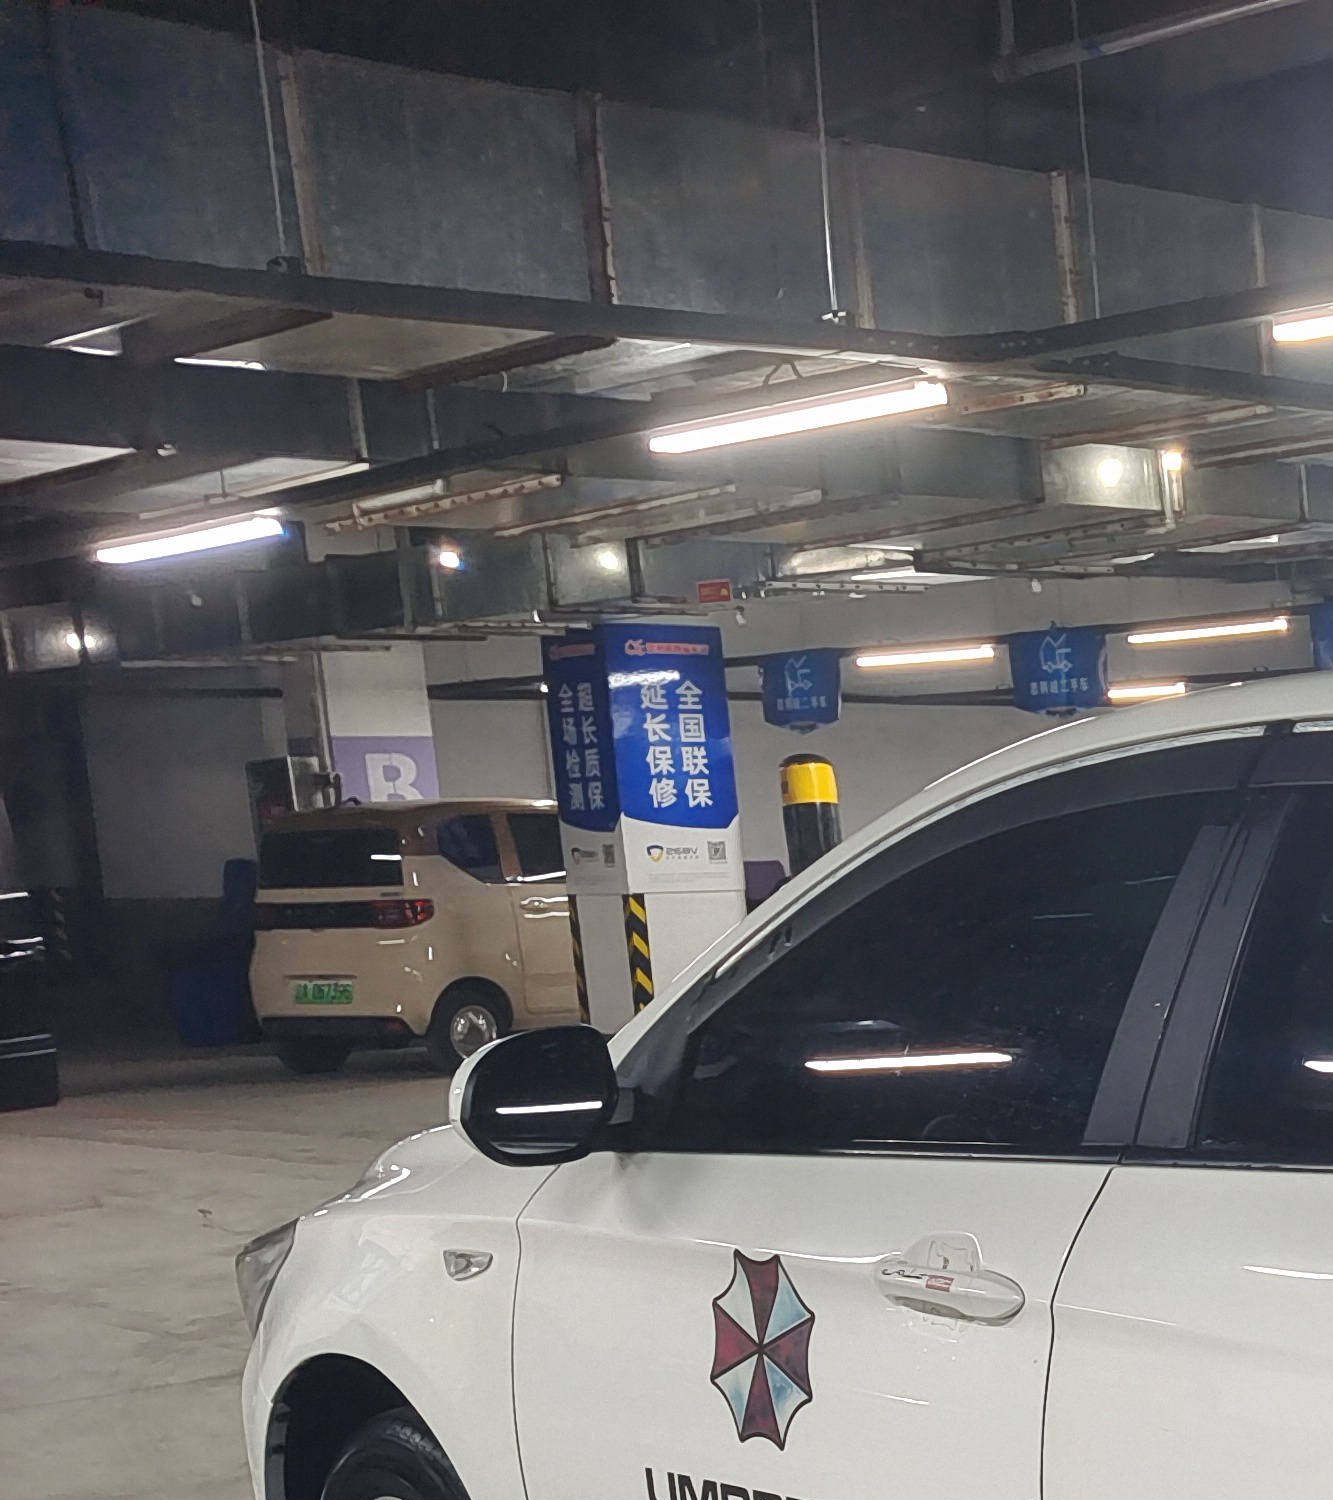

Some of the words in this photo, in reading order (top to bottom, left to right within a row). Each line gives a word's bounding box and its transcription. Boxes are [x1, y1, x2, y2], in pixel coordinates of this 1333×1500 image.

[640, 683, 678, 809] 延长保修
[675, 680, 714, 809] 全国联保
